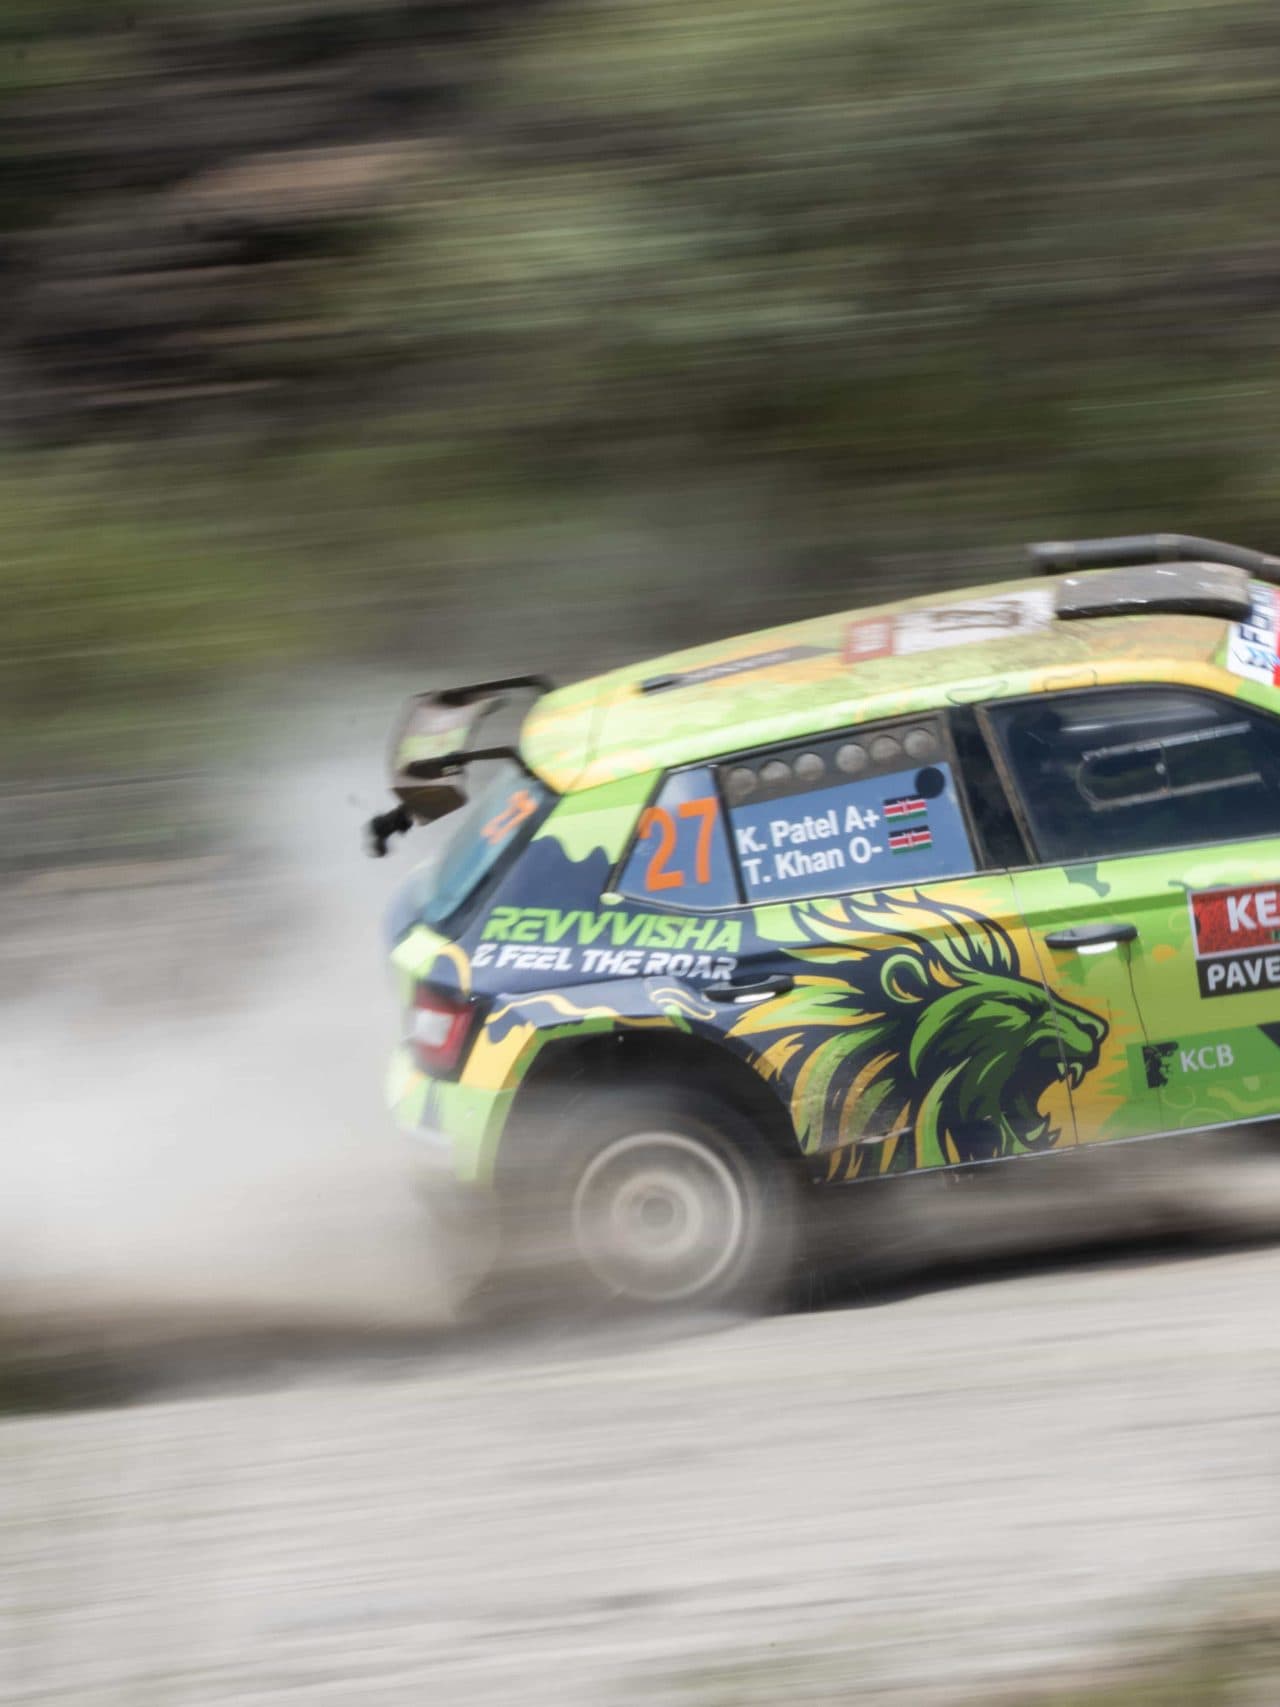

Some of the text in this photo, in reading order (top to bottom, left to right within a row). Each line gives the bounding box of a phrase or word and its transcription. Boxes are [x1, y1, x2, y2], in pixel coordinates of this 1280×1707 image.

[637, 797, 718, 891] 27
[735, 805, 880, 854] K. Patel A+
[742, 858, 771, 885] T.
[774, 848, 845, 880] Khan
[480, 906, 742, 953] REVVVISHA
[495, 944, 573, 971] FEEL
[581, 949, 644, 975] THE
[643, 953, 738, 980] ROAR
[1180, 1044, 1234, 1072] KCB
